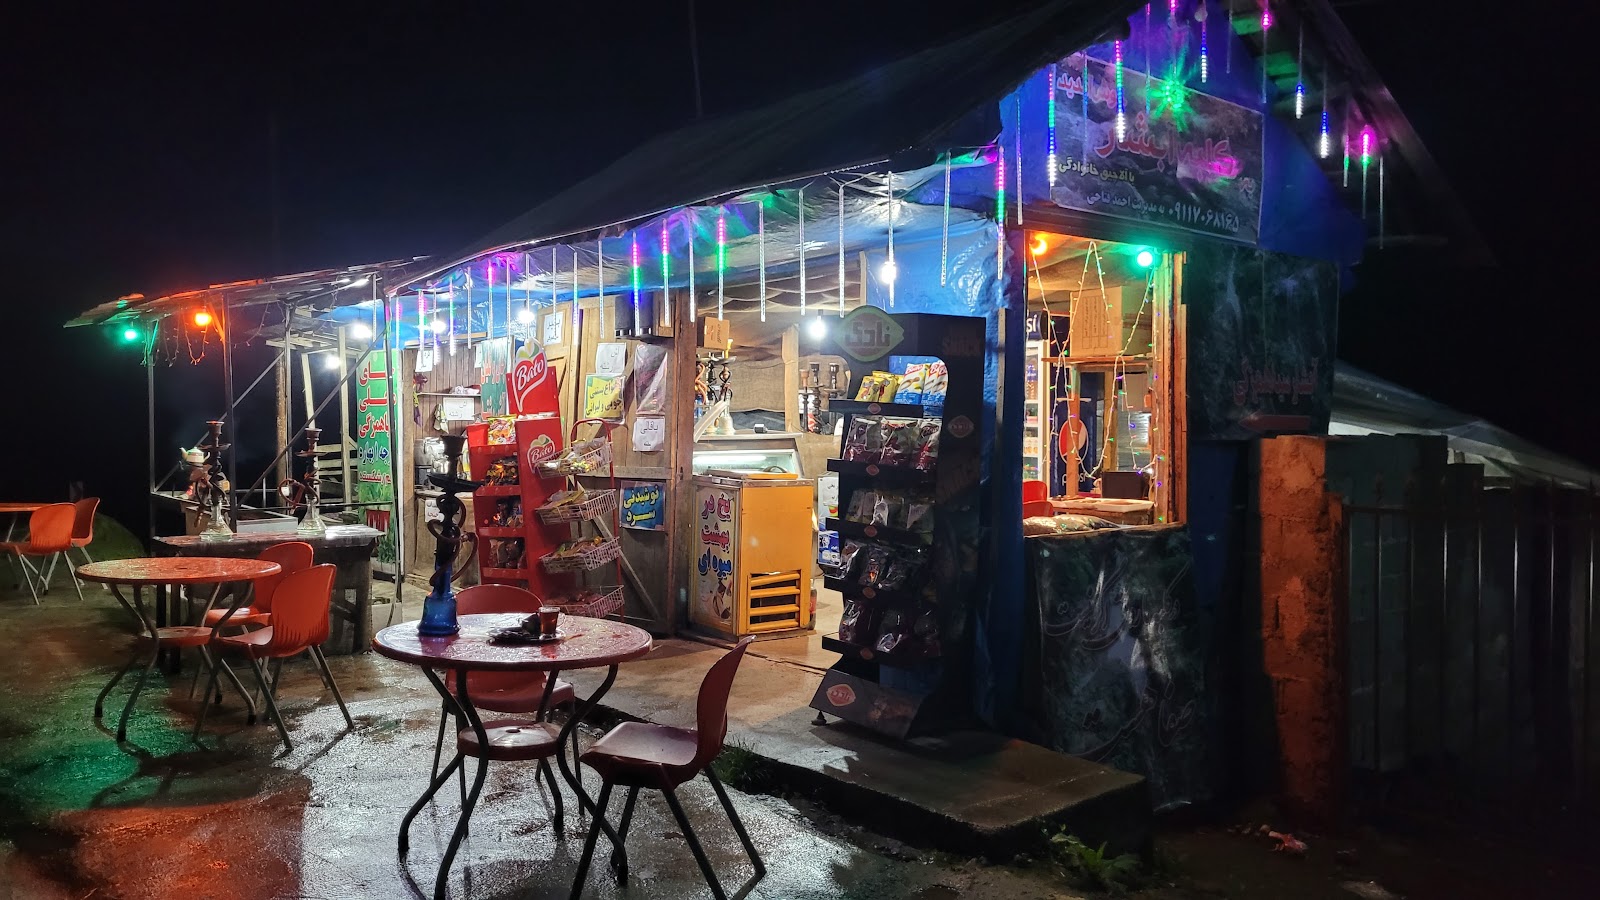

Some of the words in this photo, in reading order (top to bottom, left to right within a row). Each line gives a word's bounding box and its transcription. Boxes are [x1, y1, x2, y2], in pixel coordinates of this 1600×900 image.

[359, 360, 395, 386] ای
[516, 357, 545, 391] Bato
[531, 444, 553, 463] Bato
[1062, 472, 1086, 487] psi
[623, 484, 660, 509] نوشیدنی
[701, 494, 716, 519] در
[716, 493, 732, 521] یخ
[626, 510, 657, 527] سرد
[701, 522, 731, 554] بهشت
[711, 554, 732, 581] میوه
